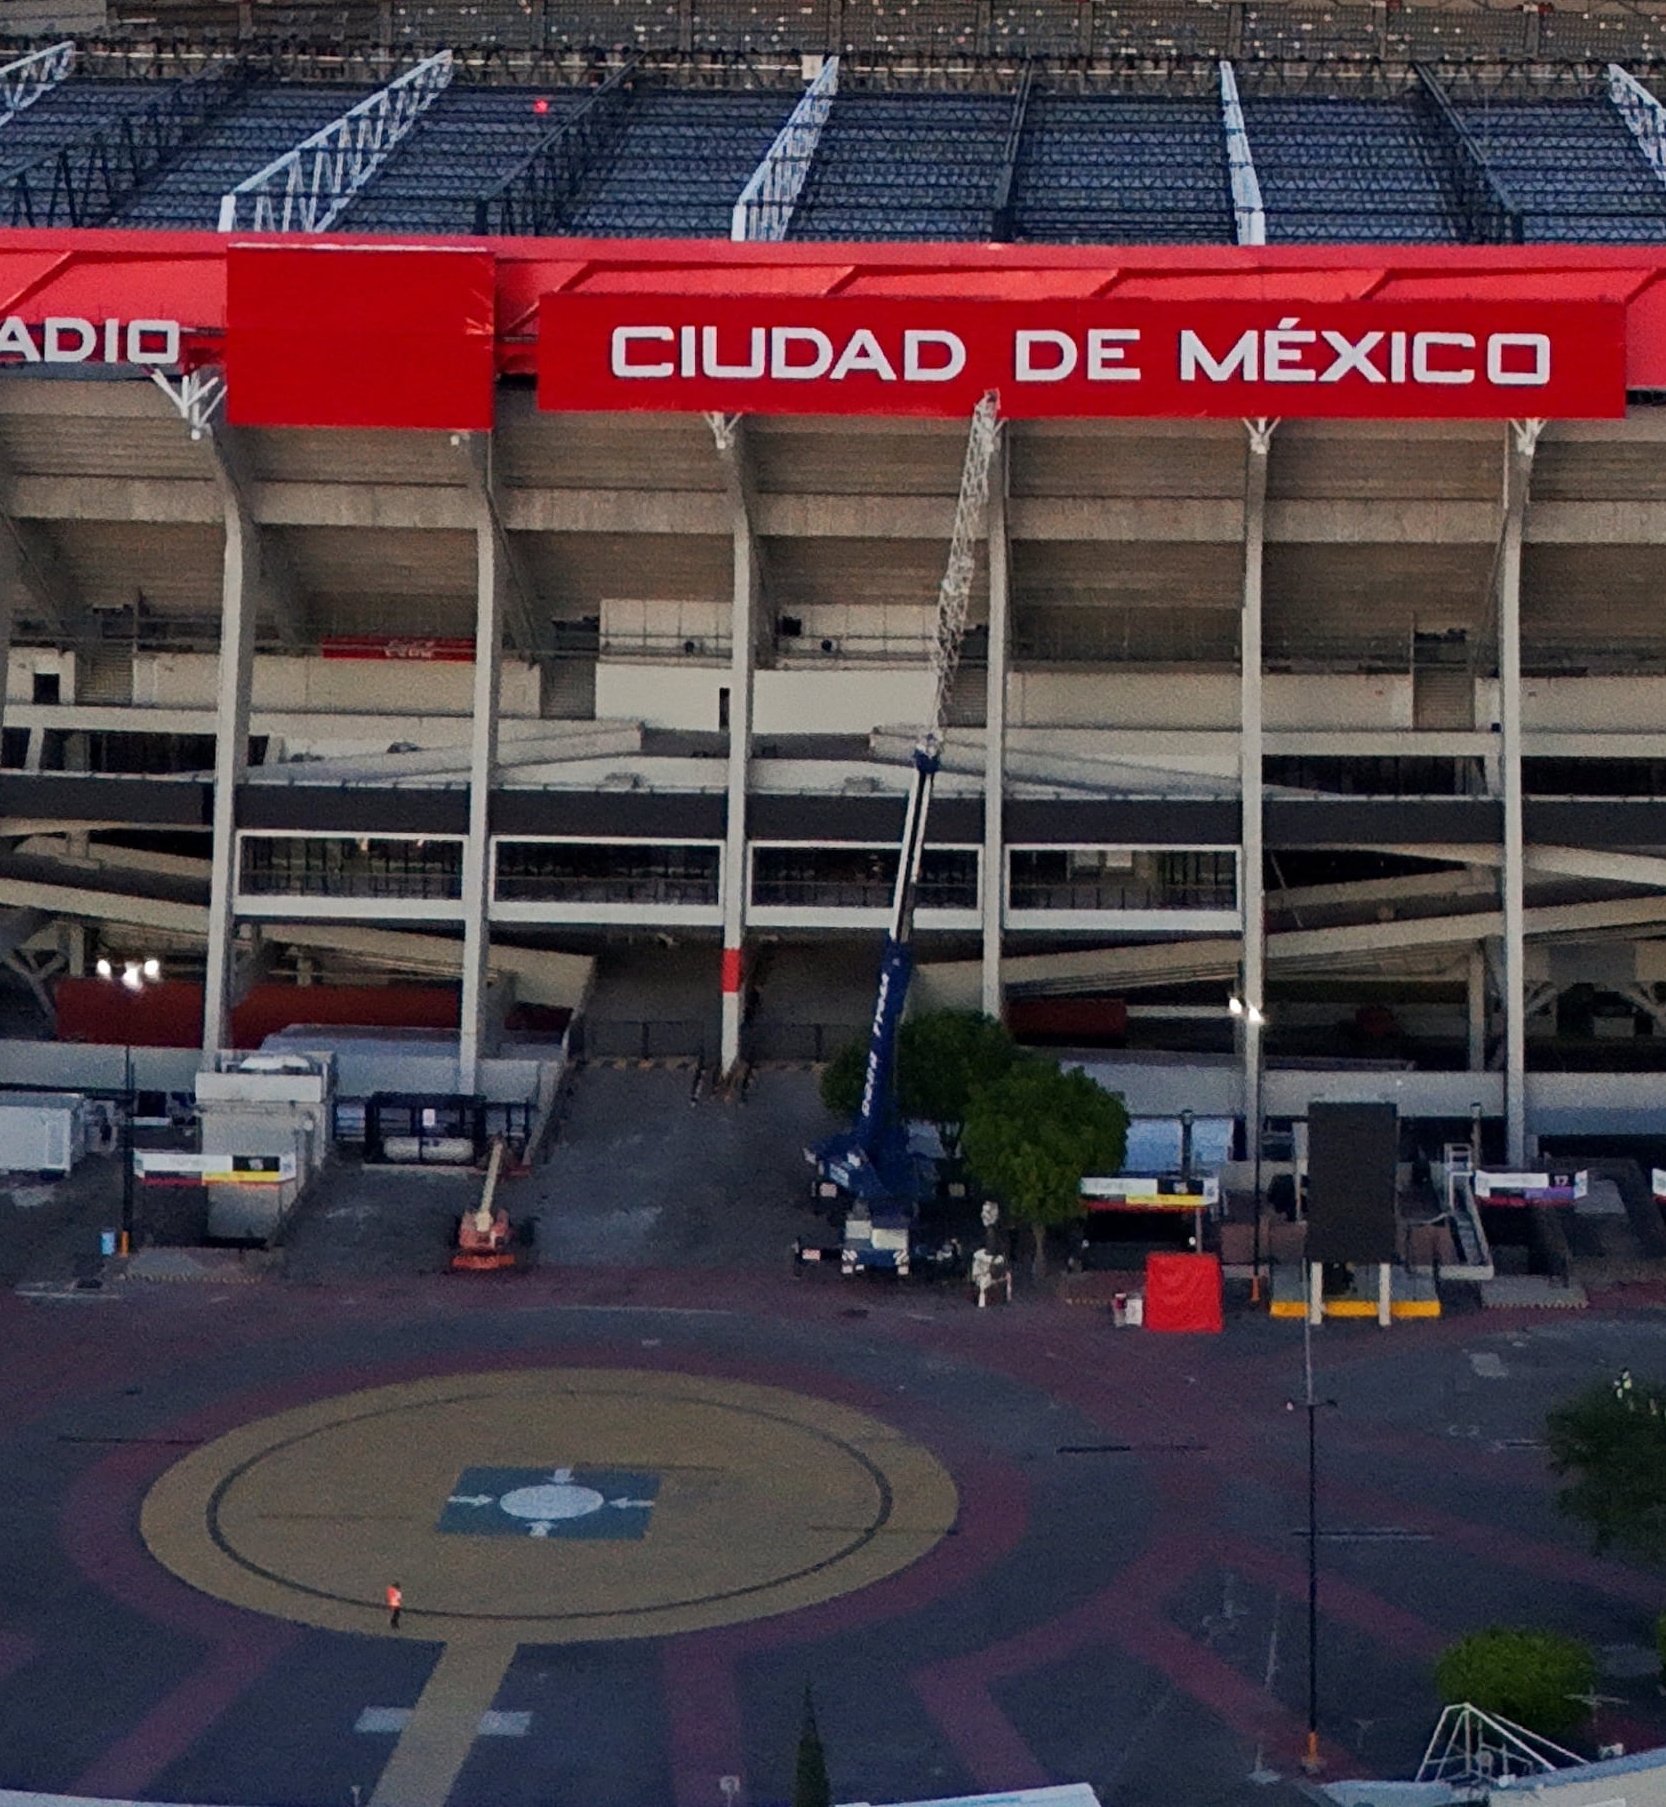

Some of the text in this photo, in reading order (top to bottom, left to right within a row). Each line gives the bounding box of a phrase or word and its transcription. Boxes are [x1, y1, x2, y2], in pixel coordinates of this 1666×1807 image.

[611, 317, 1551, 386] CIUDAD DE MÉXICO
